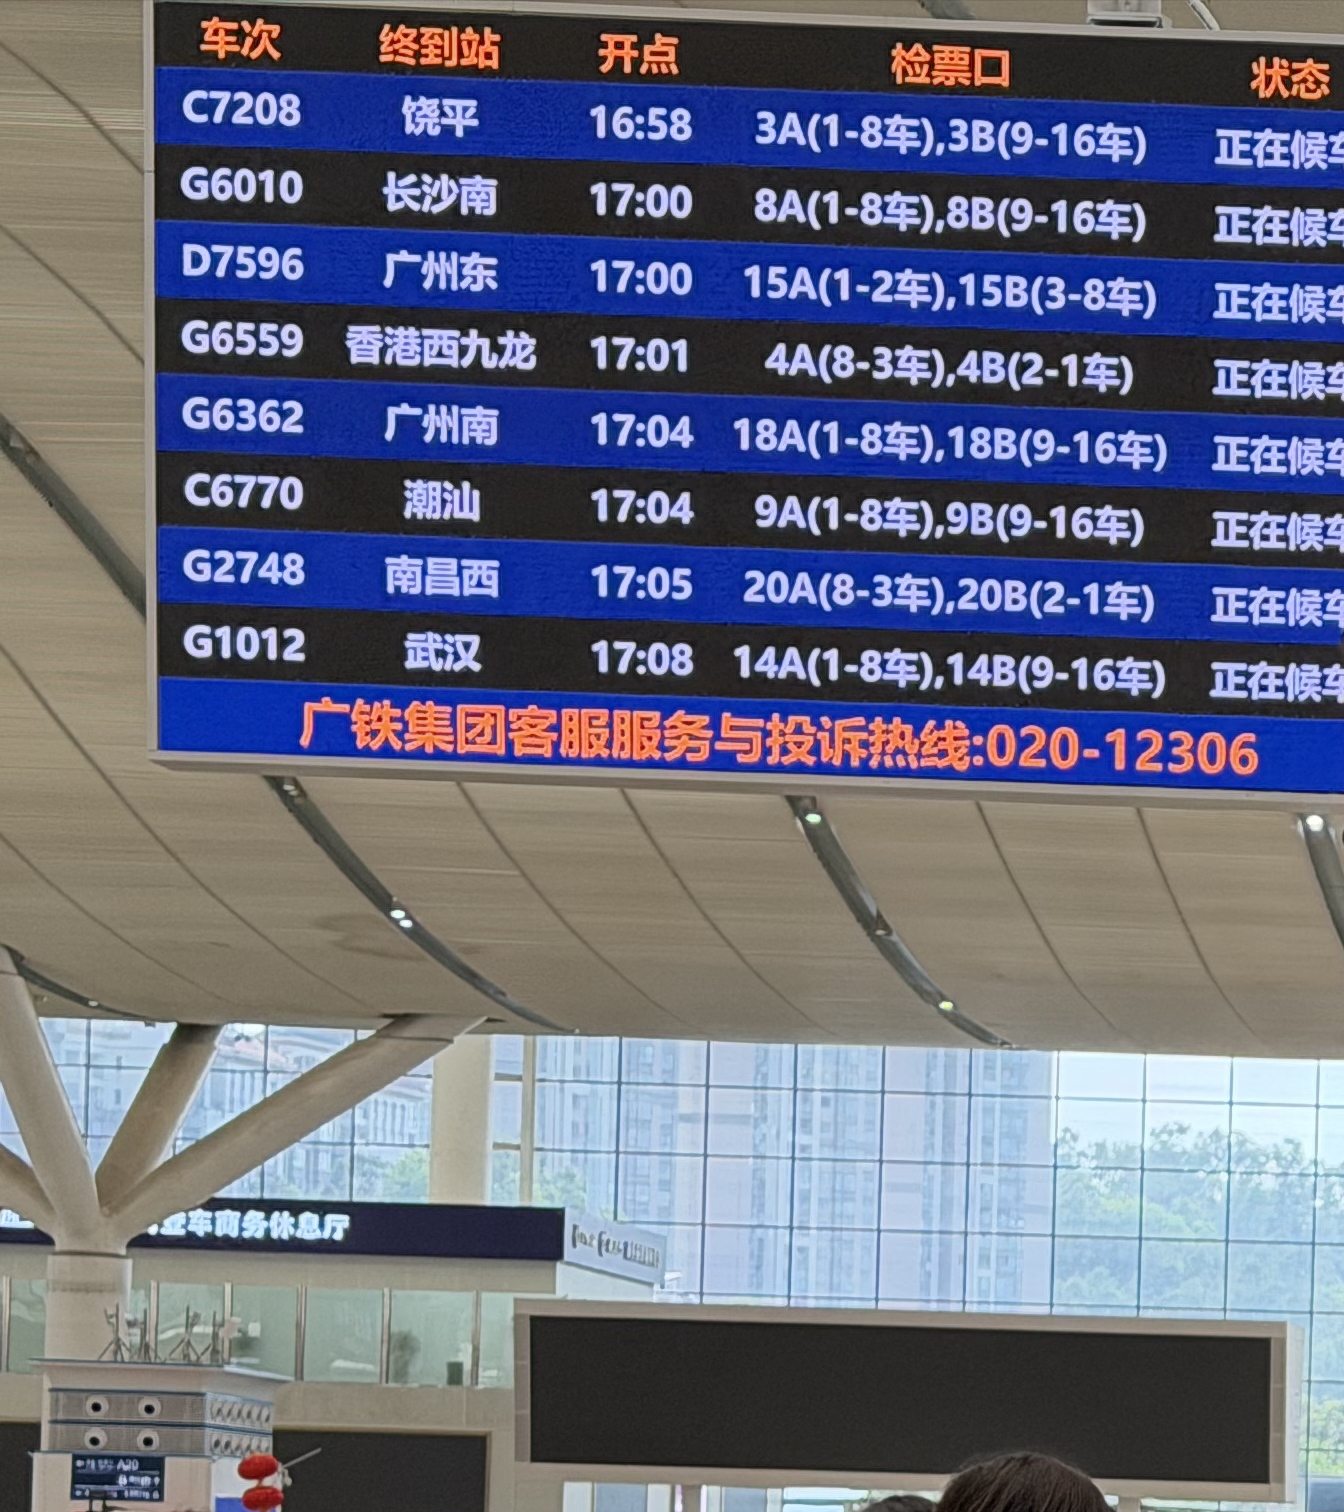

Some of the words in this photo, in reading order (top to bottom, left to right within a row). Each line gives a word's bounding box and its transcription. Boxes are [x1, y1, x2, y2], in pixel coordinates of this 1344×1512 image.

[199, 16, 282, 61] 车次
[378, 23, 502, 70] 终到站
[597, 32, 680, 75] 开点
[891, 42, 1010, 88] 检票口
[1250, 56, 1331, 100] 状态
[182, 89, 301, 127] C7208
[401, 95, 480, 138] 饶平
[590, 104, 693, 141] 16:58
[755, 110, 1147, 166] 3A(1-8车),3B(9-16车)
[180, 166, 304, 204] G6010
[382, 171, 499, 216] 长沙南
[590, 182, 693, 219] 17:00
[754, 187, 1146, 243] 8A(1-8车),8B(9-16车)
[182, 243, 304, 281] D7596
[383, 249, 498, 292] 广州东
[590, 259, 693, 296] 17:00
[744, 264, 1157, 320] 15A(1-2车),15B(3-8车)
[181, 319, 304, 358] G6559
[345, 325, 537, 371] 香港西九龙
[590, 335, 688, 373] 17:01
[764, 342, 1134, 396] 4A(8-3车),4B(2-1车)
[182, 396, 304, 434] G6362
[384, 402, 500, 446] 广州南
[591, 412, 695, 449] 17:04
[733, 417, 1167, 472] 18A(1-8车),18B(9-16车)
[184, 472, 304, 510] C6770
[403, 479, 481, 522] 潮汕
[590, 488, 695, 525] 17:04
[754, 494, 1145, 548] 9A(1-8车),9B(9-16车)
[183, 548, 305, 586] G2748
[384, 554, 500, 598] 南昌西
[591, 564, 693, 600] 17:05
[743, 570, 1155, 623] 20A(8-3车),20B(2-1车)
[183, 624, 306, 662] G1012
[404, 631, 482, 673] 武汉
[591, 639, 694, 676] 17:08
[733, 644, 1166, 699] 14A(1-8车),14B(9-16车)
[300, 697, 1261, 778] 广铁集团客服服务与投诉热线:020-12306
